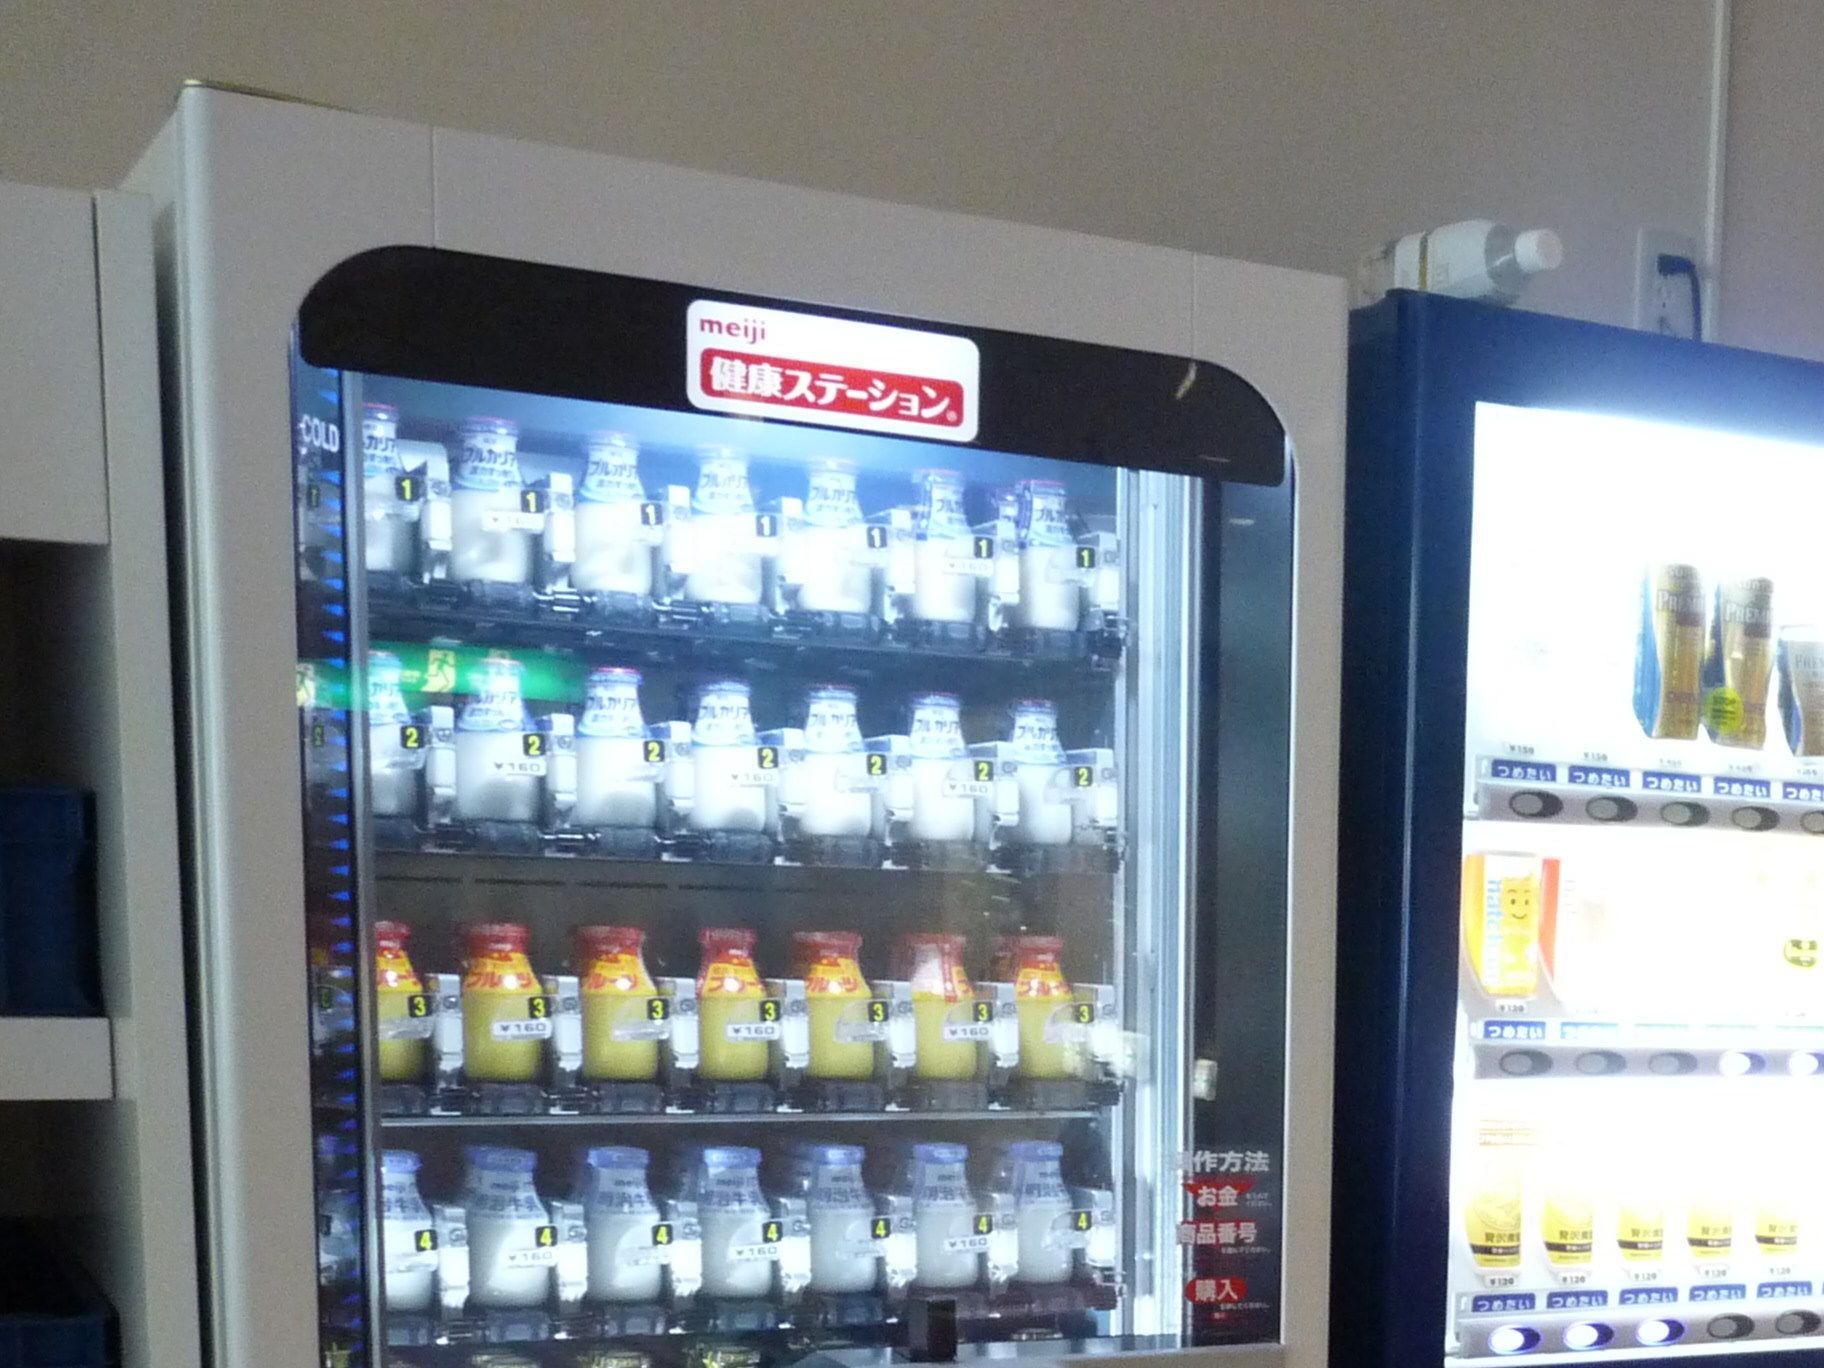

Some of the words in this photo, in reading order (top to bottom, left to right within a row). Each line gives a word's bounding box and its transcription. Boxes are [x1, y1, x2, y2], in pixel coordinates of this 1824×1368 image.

[698, 316, 767, 343] meiji
[709, 356, 951, 420] 健康ステーション
[302, 414, 340, 452] COLD
[414, 996, 427, 1017] 3
[532, 997, 546, 1018] 3
[651, 999, 664, 1018] 3
[763, 1000, 776, 1020] 3
[872, 1002, 885, 1021] 3
[977, 1002, 989, 1020] 3
[1077, 1003, 1090, 1021] 3
[500, 1022, 547, 1033] ¥160
[732, 1026, 775, 1036] ¥160
[949, 1027, 989, 1037] ¥160
[1196, 1185, 1238, 1206] お金
[949, 1237, 988, 1248] ¥160
[1195, 1279, 1238, 1301] 購入
[1476, 1298, 1530, 1312] つめたい
[1552, 1294, 1603, 1309] つめたい
